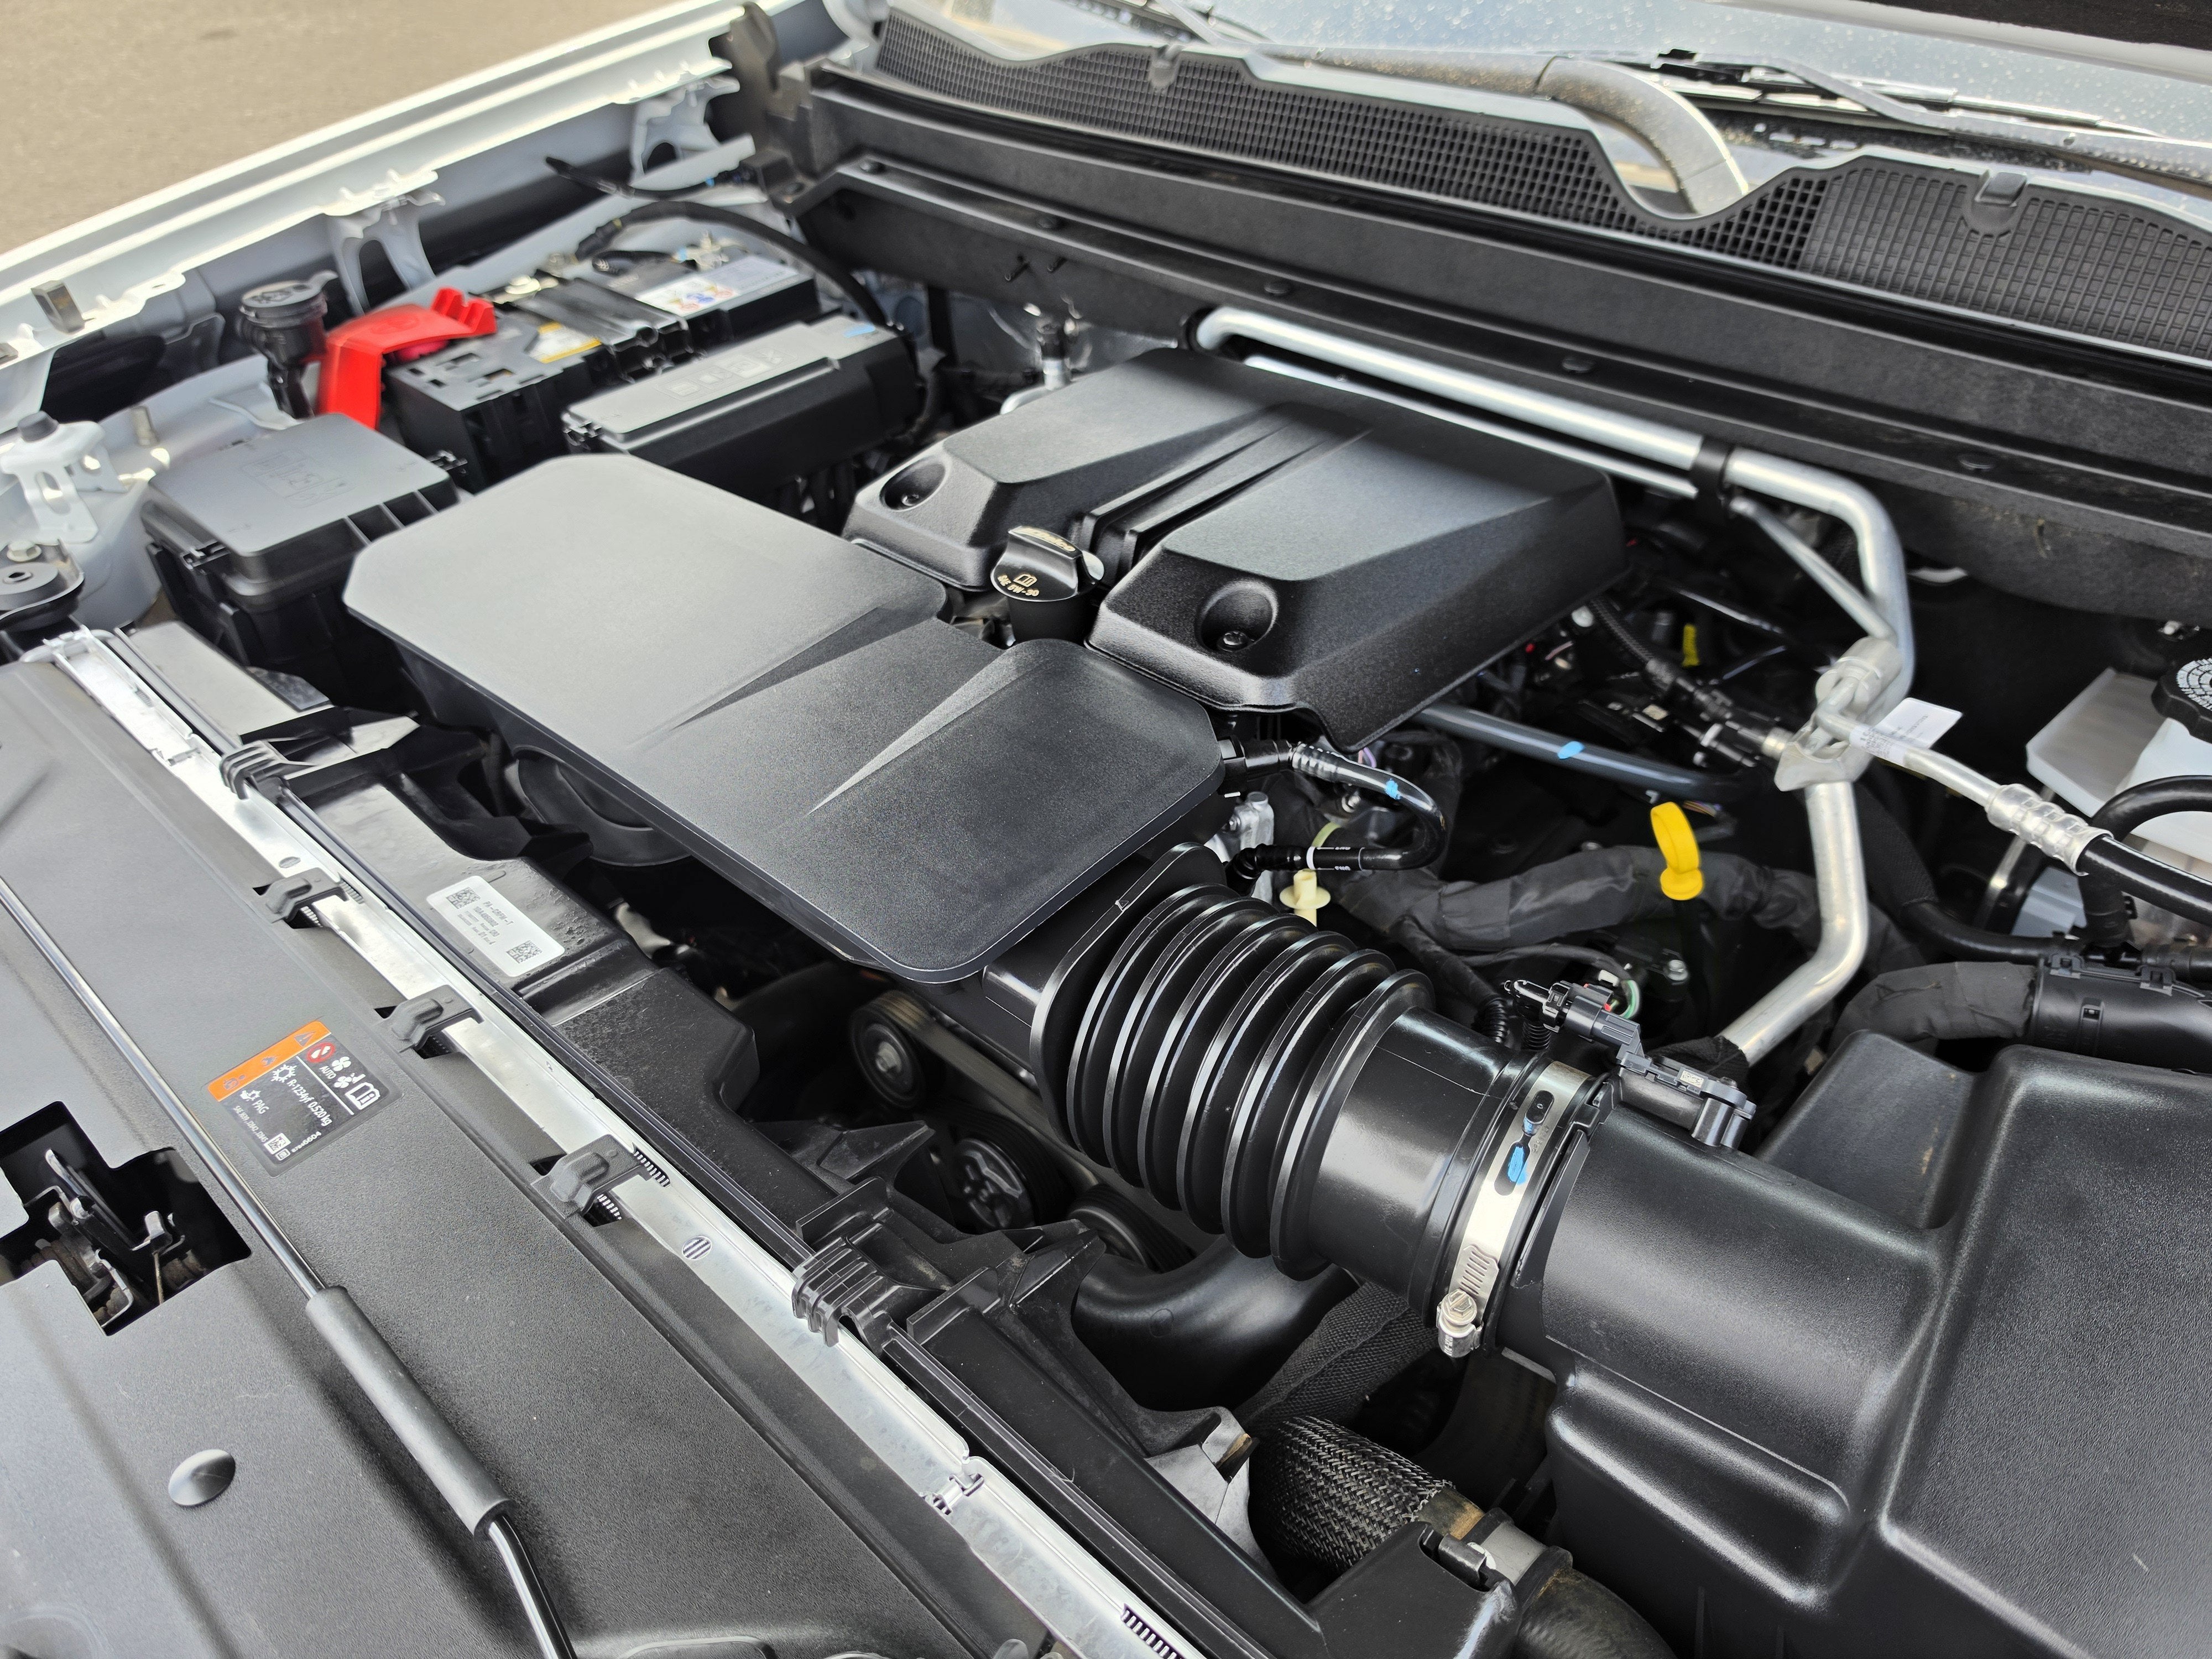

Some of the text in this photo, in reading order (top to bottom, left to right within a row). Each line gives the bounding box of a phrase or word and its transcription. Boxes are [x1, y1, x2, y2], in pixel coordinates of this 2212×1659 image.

[319, 1065, 337, 1080] AUTO
[286, 1078, 315, 1104] R-1234yf
[252, 1099, 269, 1114] PAG
